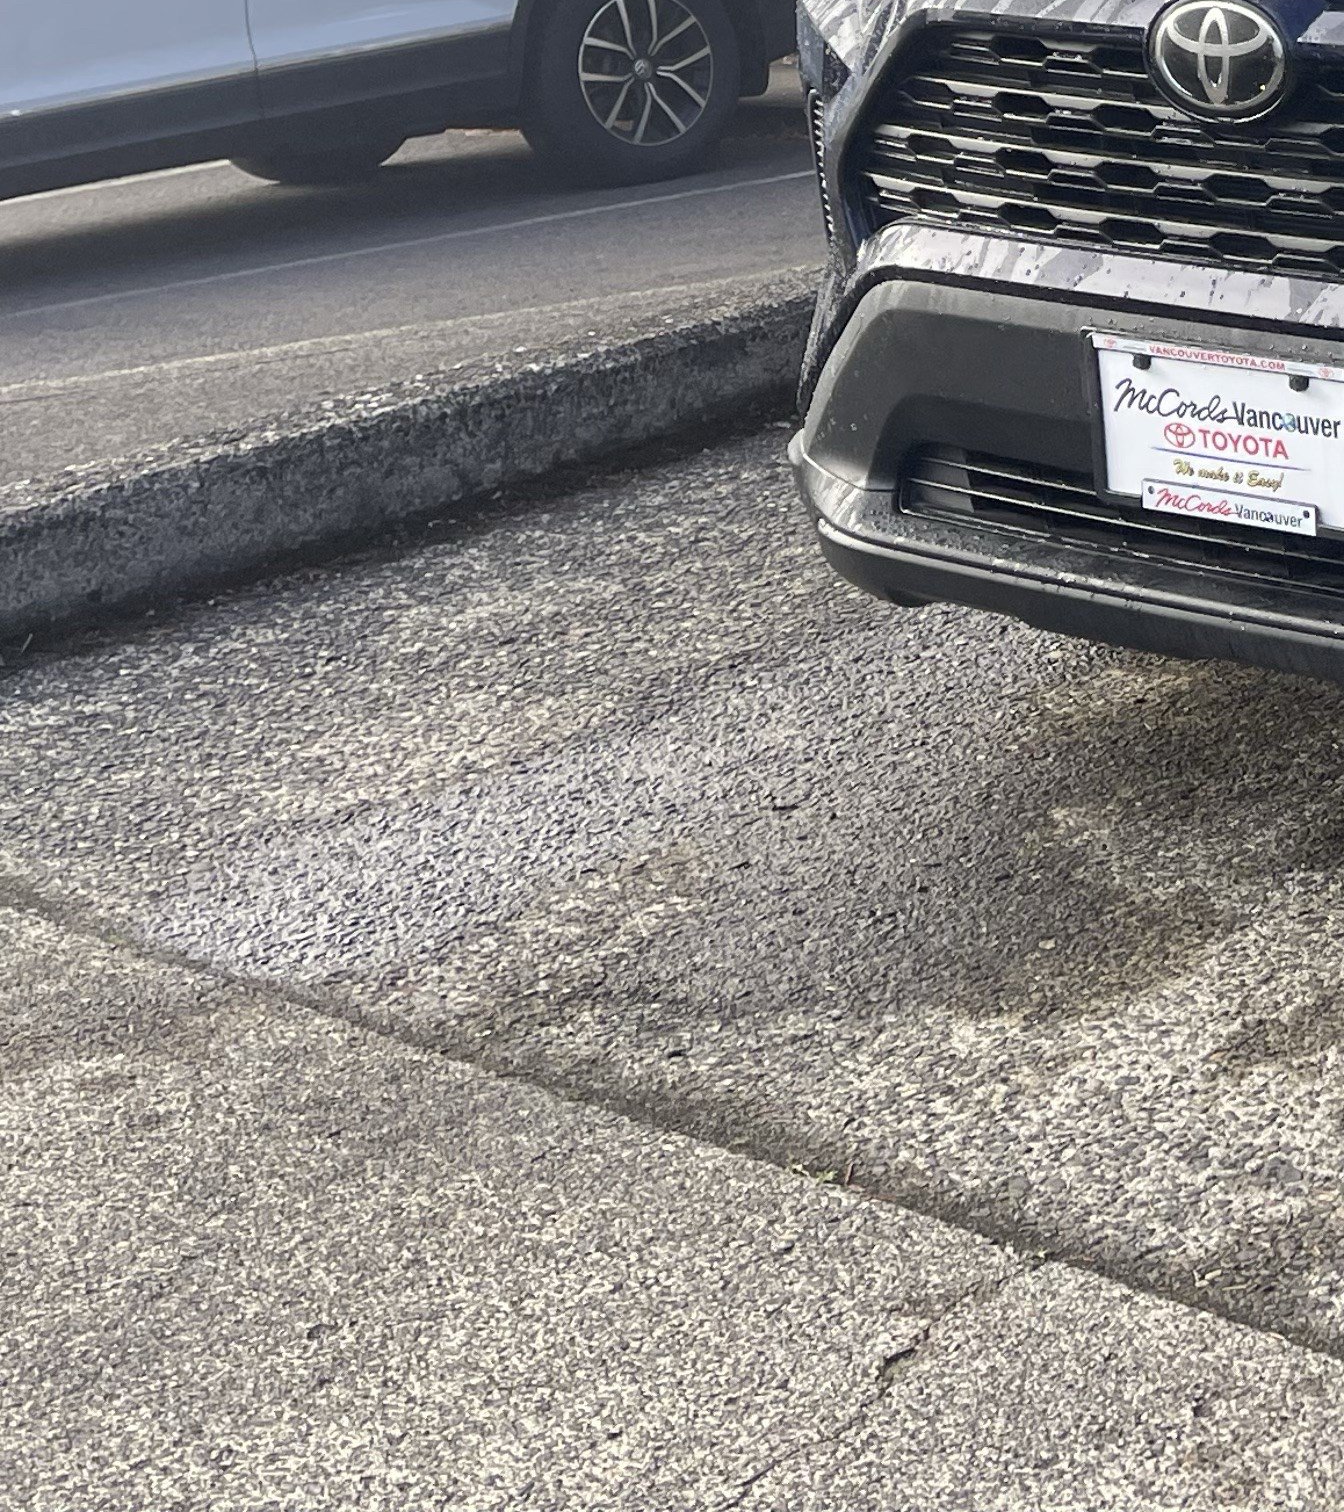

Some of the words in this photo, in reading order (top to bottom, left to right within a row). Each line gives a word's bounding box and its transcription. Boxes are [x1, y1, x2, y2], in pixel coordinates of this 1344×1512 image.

[1149, 345, 1285, 370] VANCOUVERTOYOTA.COM
[1198, 429, 1289, 460] TOYOTA
[1198, 466, 1230, 482] make
[1232, 471, 1243, 484] it
